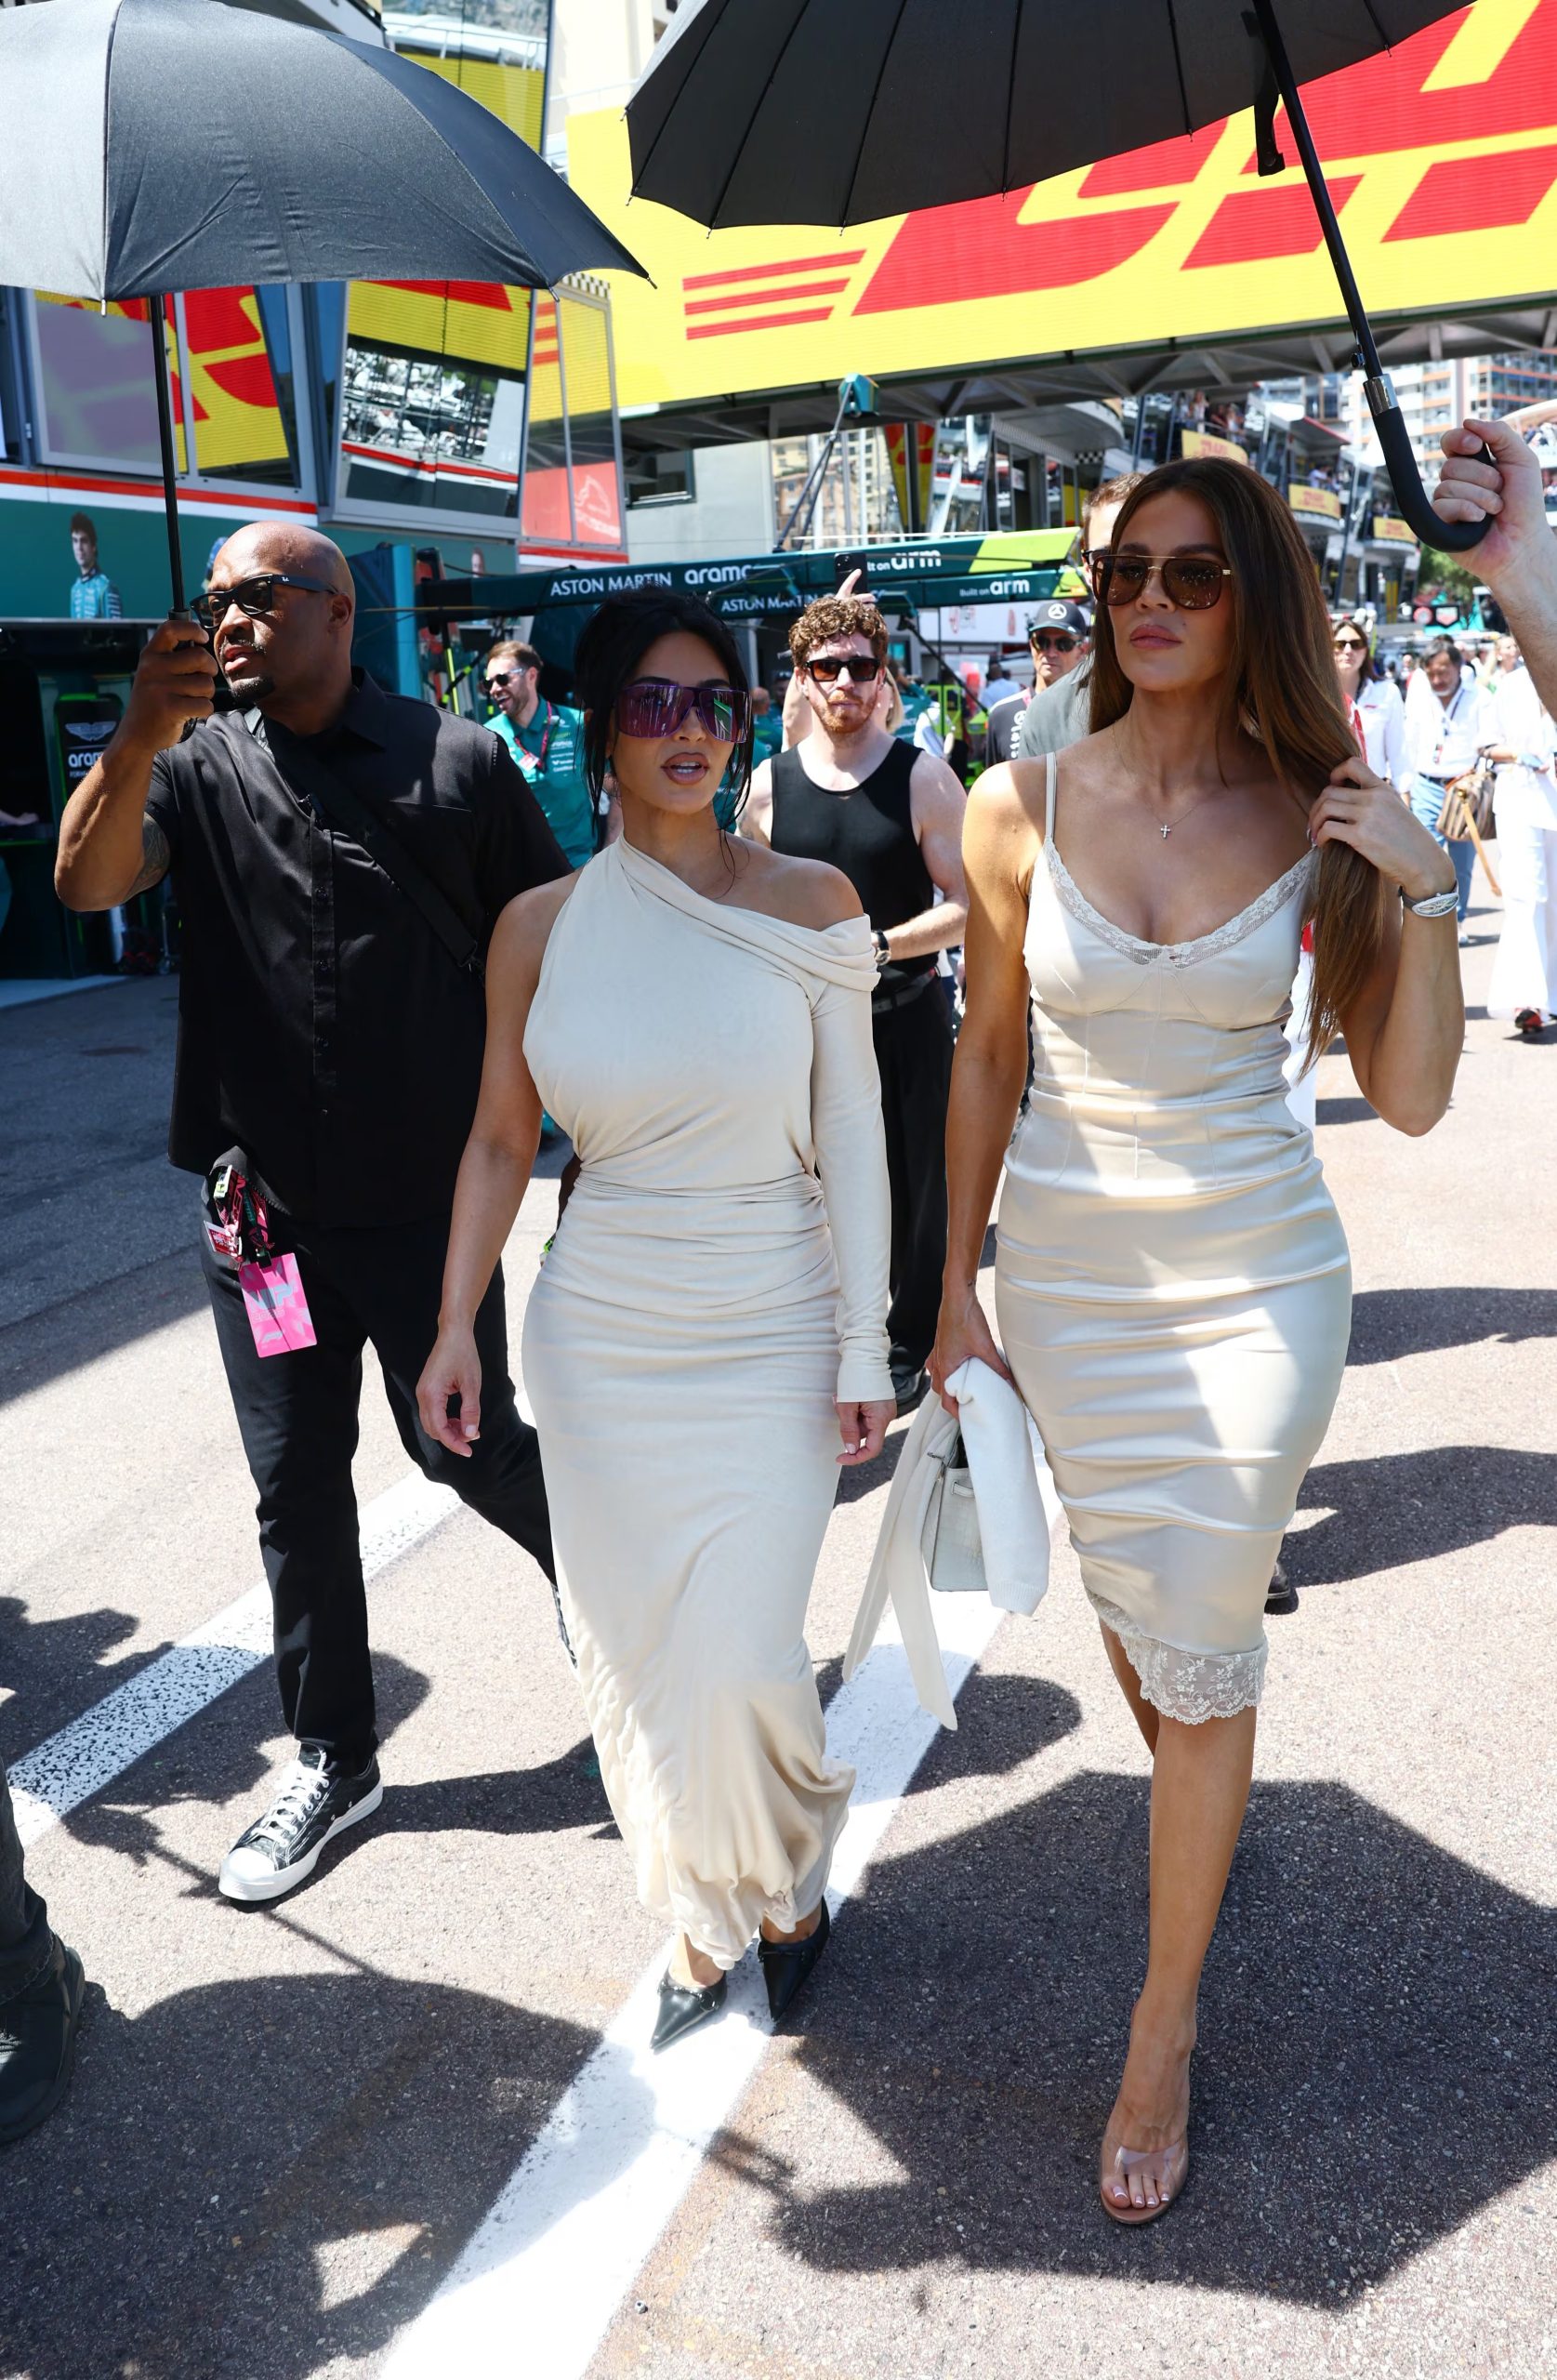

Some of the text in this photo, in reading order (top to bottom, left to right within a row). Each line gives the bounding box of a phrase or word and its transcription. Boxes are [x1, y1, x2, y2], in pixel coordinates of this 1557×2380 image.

[891, 549, 942, 571] arm
[550, 572, 672, 597] ASTON MARTIN
[684, 564, 752, 585] aramc
[989, 579, 1030, 596] arm
